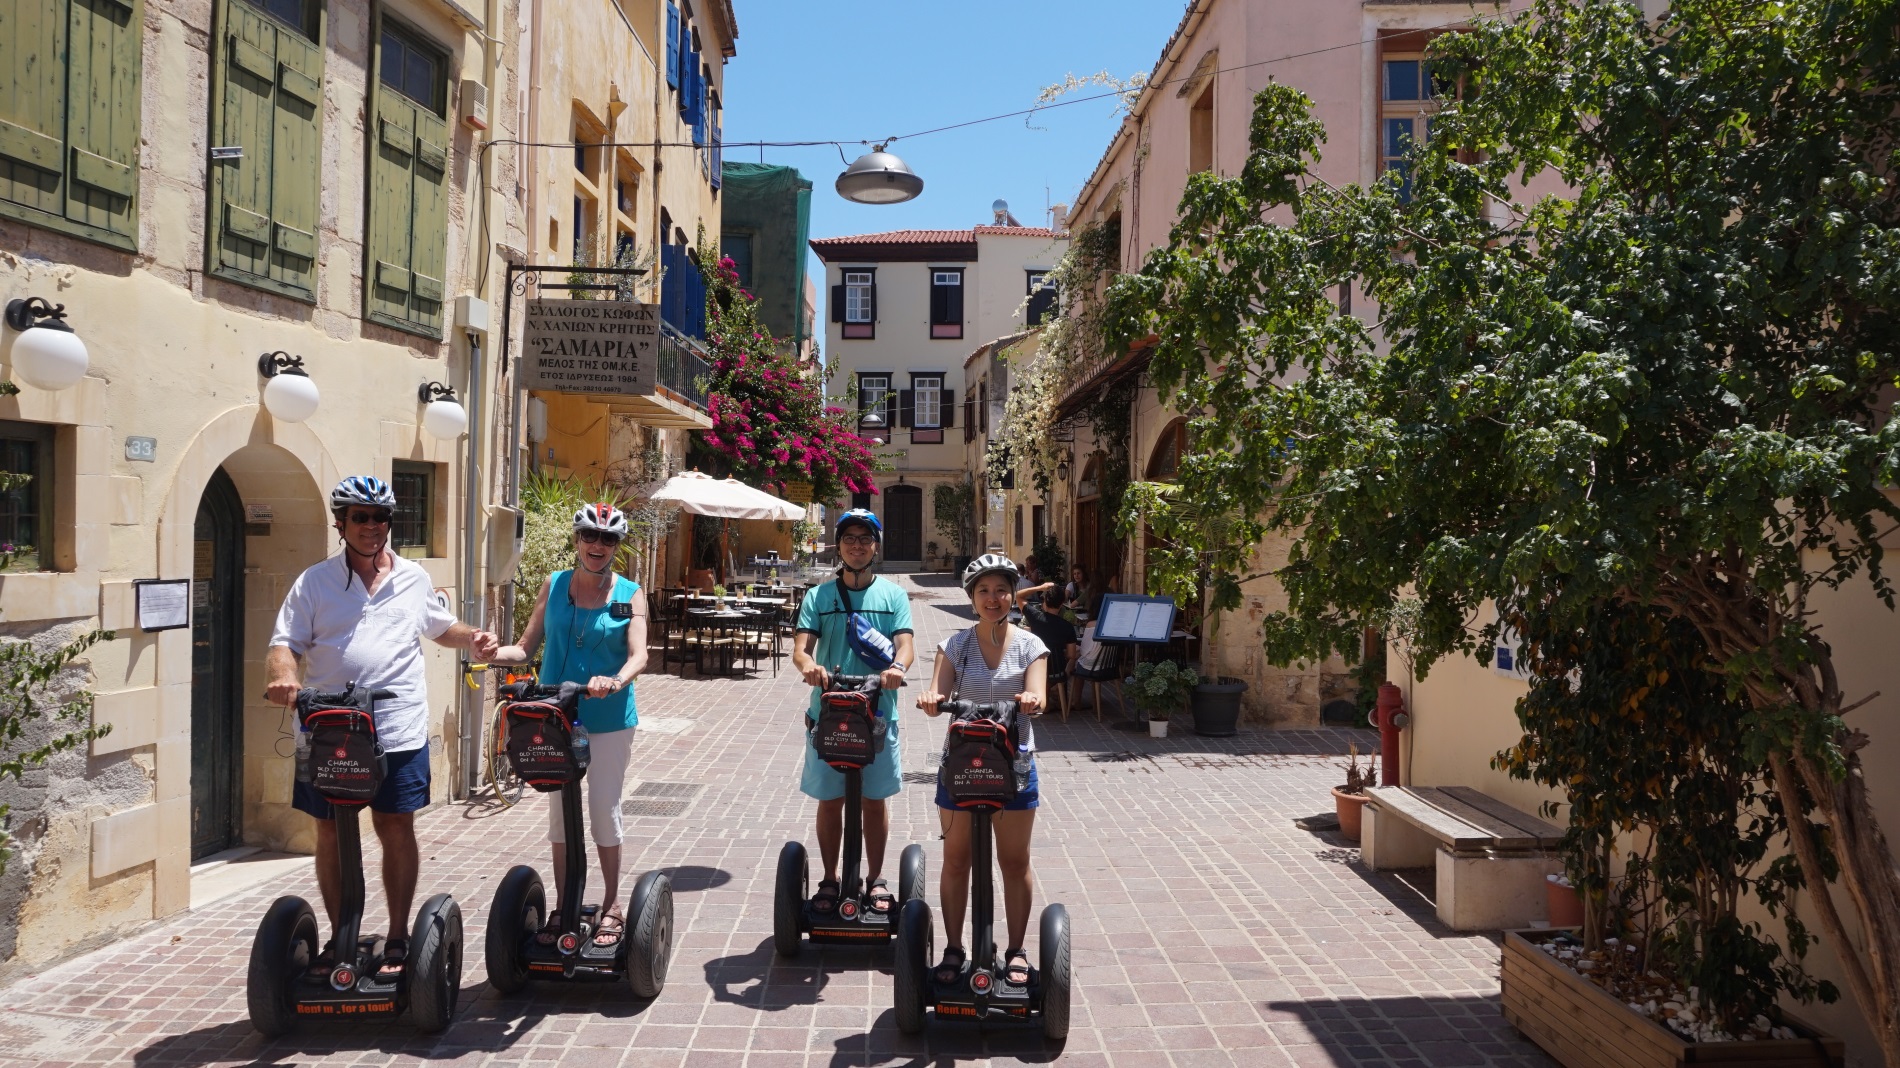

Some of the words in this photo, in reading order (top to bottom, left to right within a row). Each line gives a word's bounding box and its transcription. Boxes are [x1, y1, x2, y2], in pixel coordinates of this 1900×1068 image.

[529, 305, 600, 319] ΣΥΛΛΟΓΟΣ
[603, 308, 655, 321] ΚΩΦΩΝ
[527, 320, 540, 331] Ν.
[543, 321, 596, 333] ΧΑΝΙΩΝ
[599, 323, 655, 335] ΚΡΗΤΗΣ
[538, 358, 575, 369] ΜΕΛΟΣ
[578, 359, 599, 370] ΤΗΣ
[601, 361, 640, 372] ΟΜ.Κ.Ε.
[540, 371, 564, 379] ΕΤΟΣ
[566, 372, 614, 382] ΙΔΡΥΣΕΩΣ
[617, 375, 638, 383] 1984
[131, 440, 152, 456] 33
[297, 1004, 321, 1014] Rent
[341, 1003, 357, 1013] for
[359, 1004, 366, 1013] a
[367, 1001, 394, 1012] tour!
[937, 1004, 959, 1015] Rent
[961, 1007, 977, 1016] me
